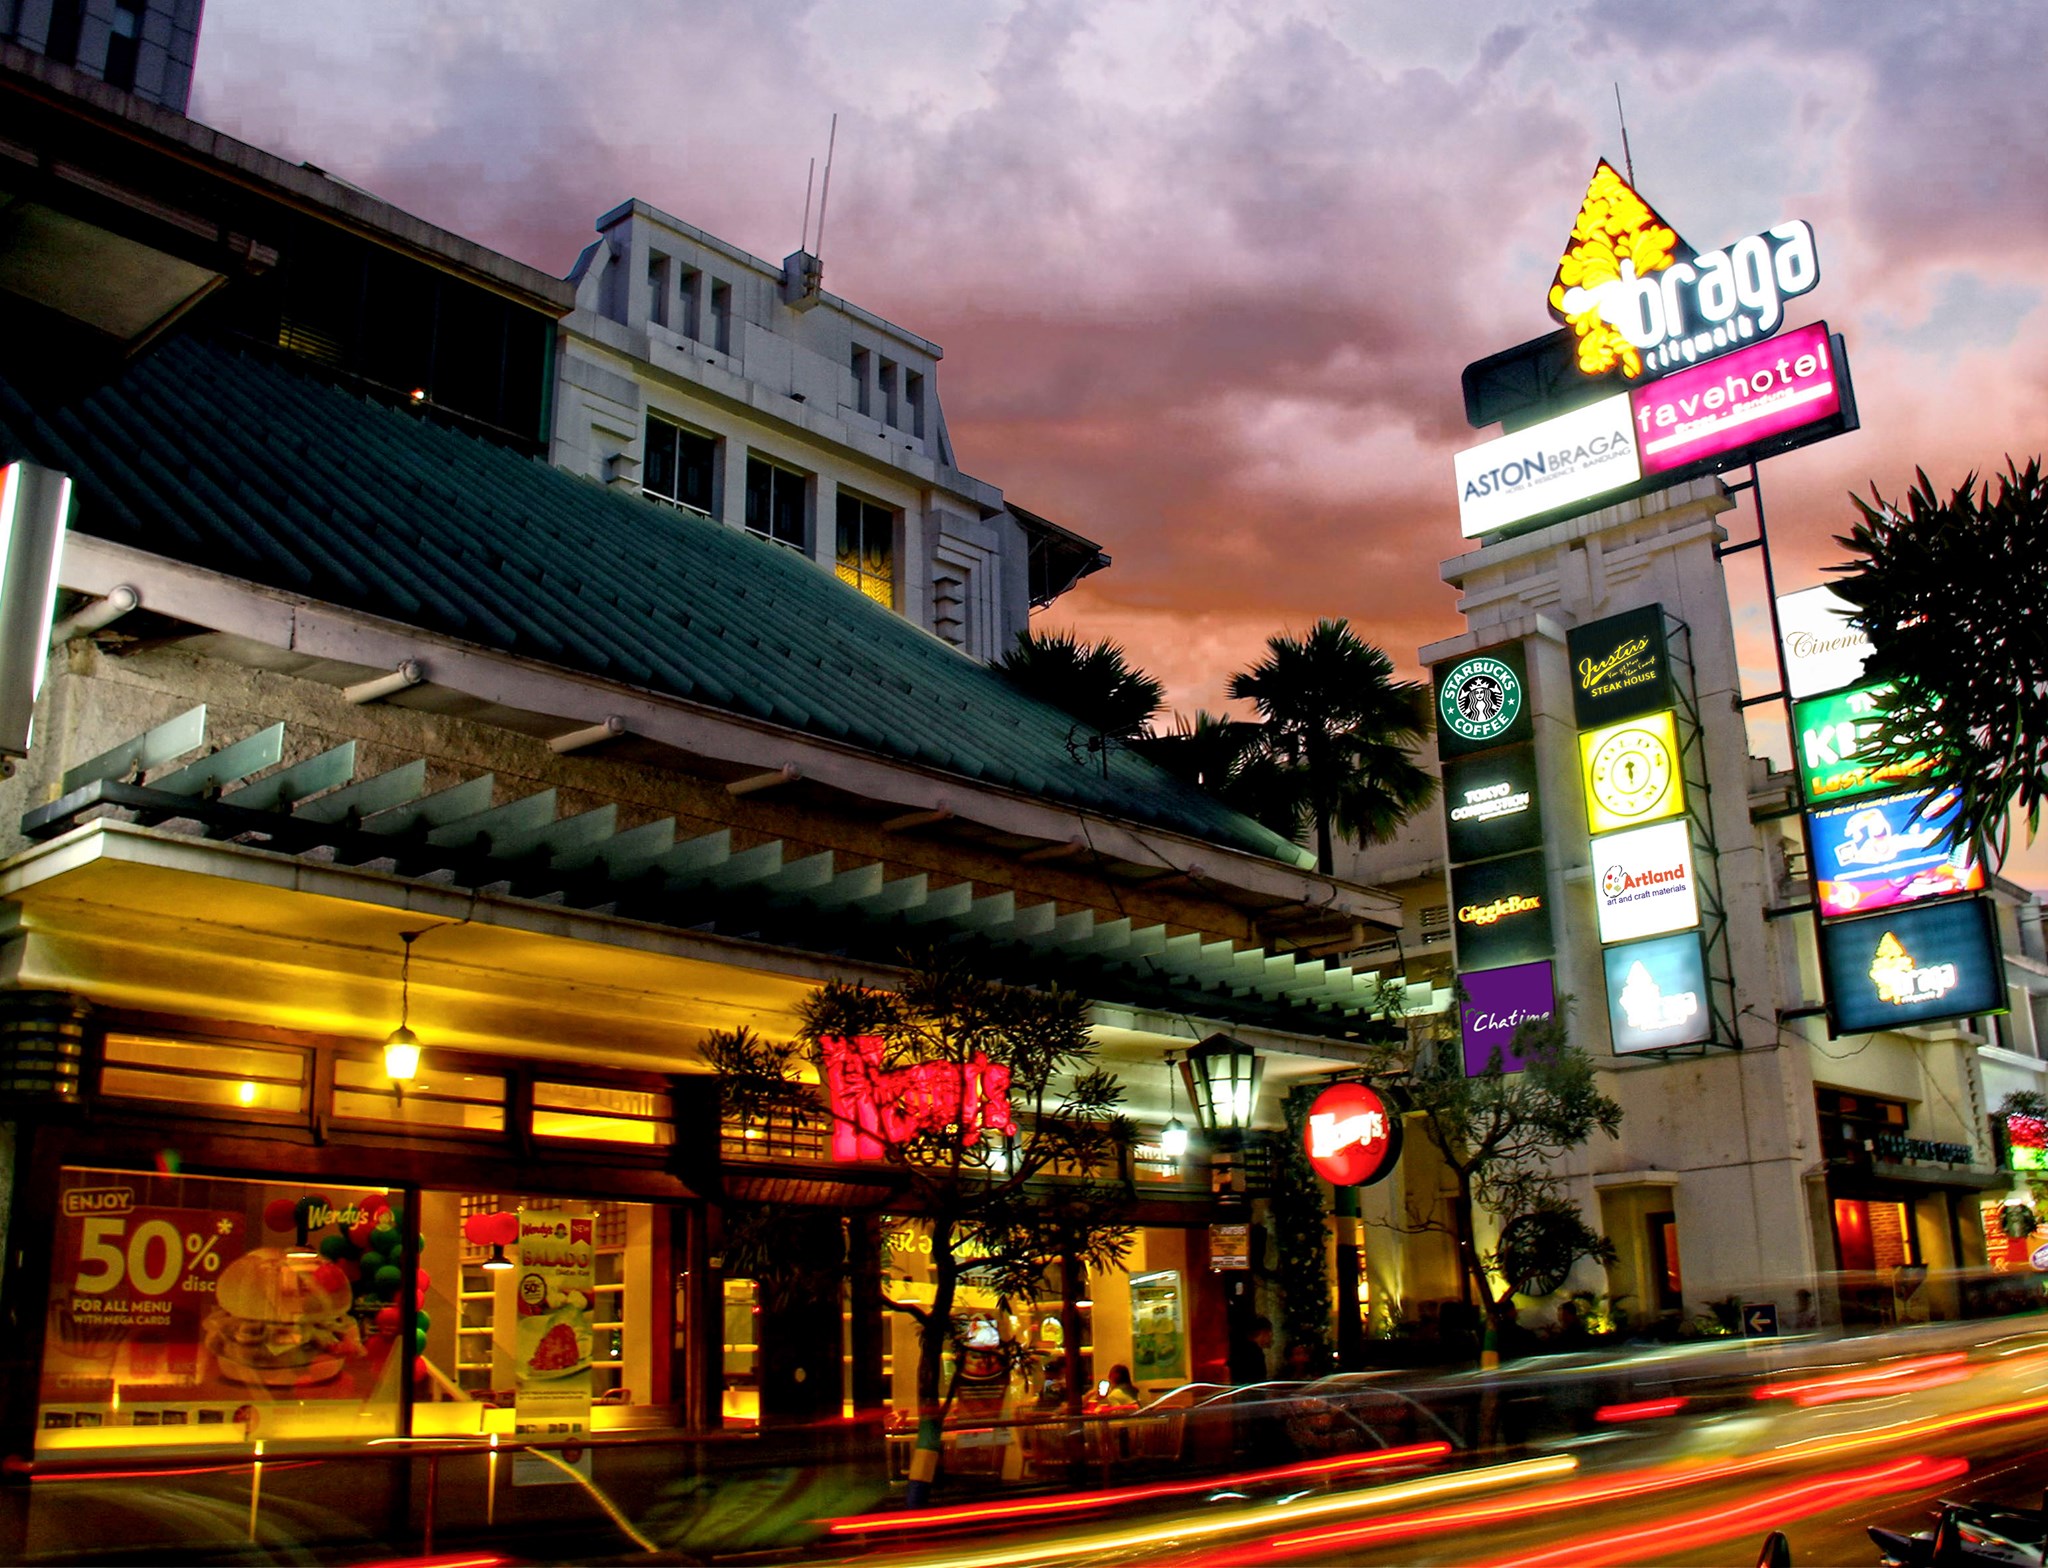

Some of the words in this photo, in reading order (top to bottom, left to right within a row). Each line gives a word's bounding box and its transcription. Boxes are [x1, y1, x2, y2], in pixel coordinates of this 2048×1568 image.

[1620, 219, 1817, 350] braga
[1638, 342, 1829, 433] favehotel
[1444, 661, 1516, 700] STARBUCKS
[1591, 681, 1623, 698] STEAK
[1624, 670, 1657, 687] HOUSE
[1454, 712, 1510, 736] COFFEE
[1623, 863, 1686, 891] Artland
[1606, 898, 1617, 906] art
[1618, 894, 1633, 904] and
[1634, 890, 1651, 901] craft
[1652, 883, 1687, 898] materials
[1458, 895, 1541, 926] GiggleBox
[1473, 1009, 1550, 1033] Chatime
[68, 1193, 130, 1211] ENJOY
[308, 1202, 369, 1230] Wendy's
[182, 1275, 216, 1292] disc
[73, 1299, 102, 1312] FOR
[104, 1300, 128, 1313] ALL
[131, 1301, 172, 1313] MENU
[73, 1315, 102, 1324] WITH
[103, 1315, 134, 1325] MEGA
[136, 1316, 171, 1326] CARDS
